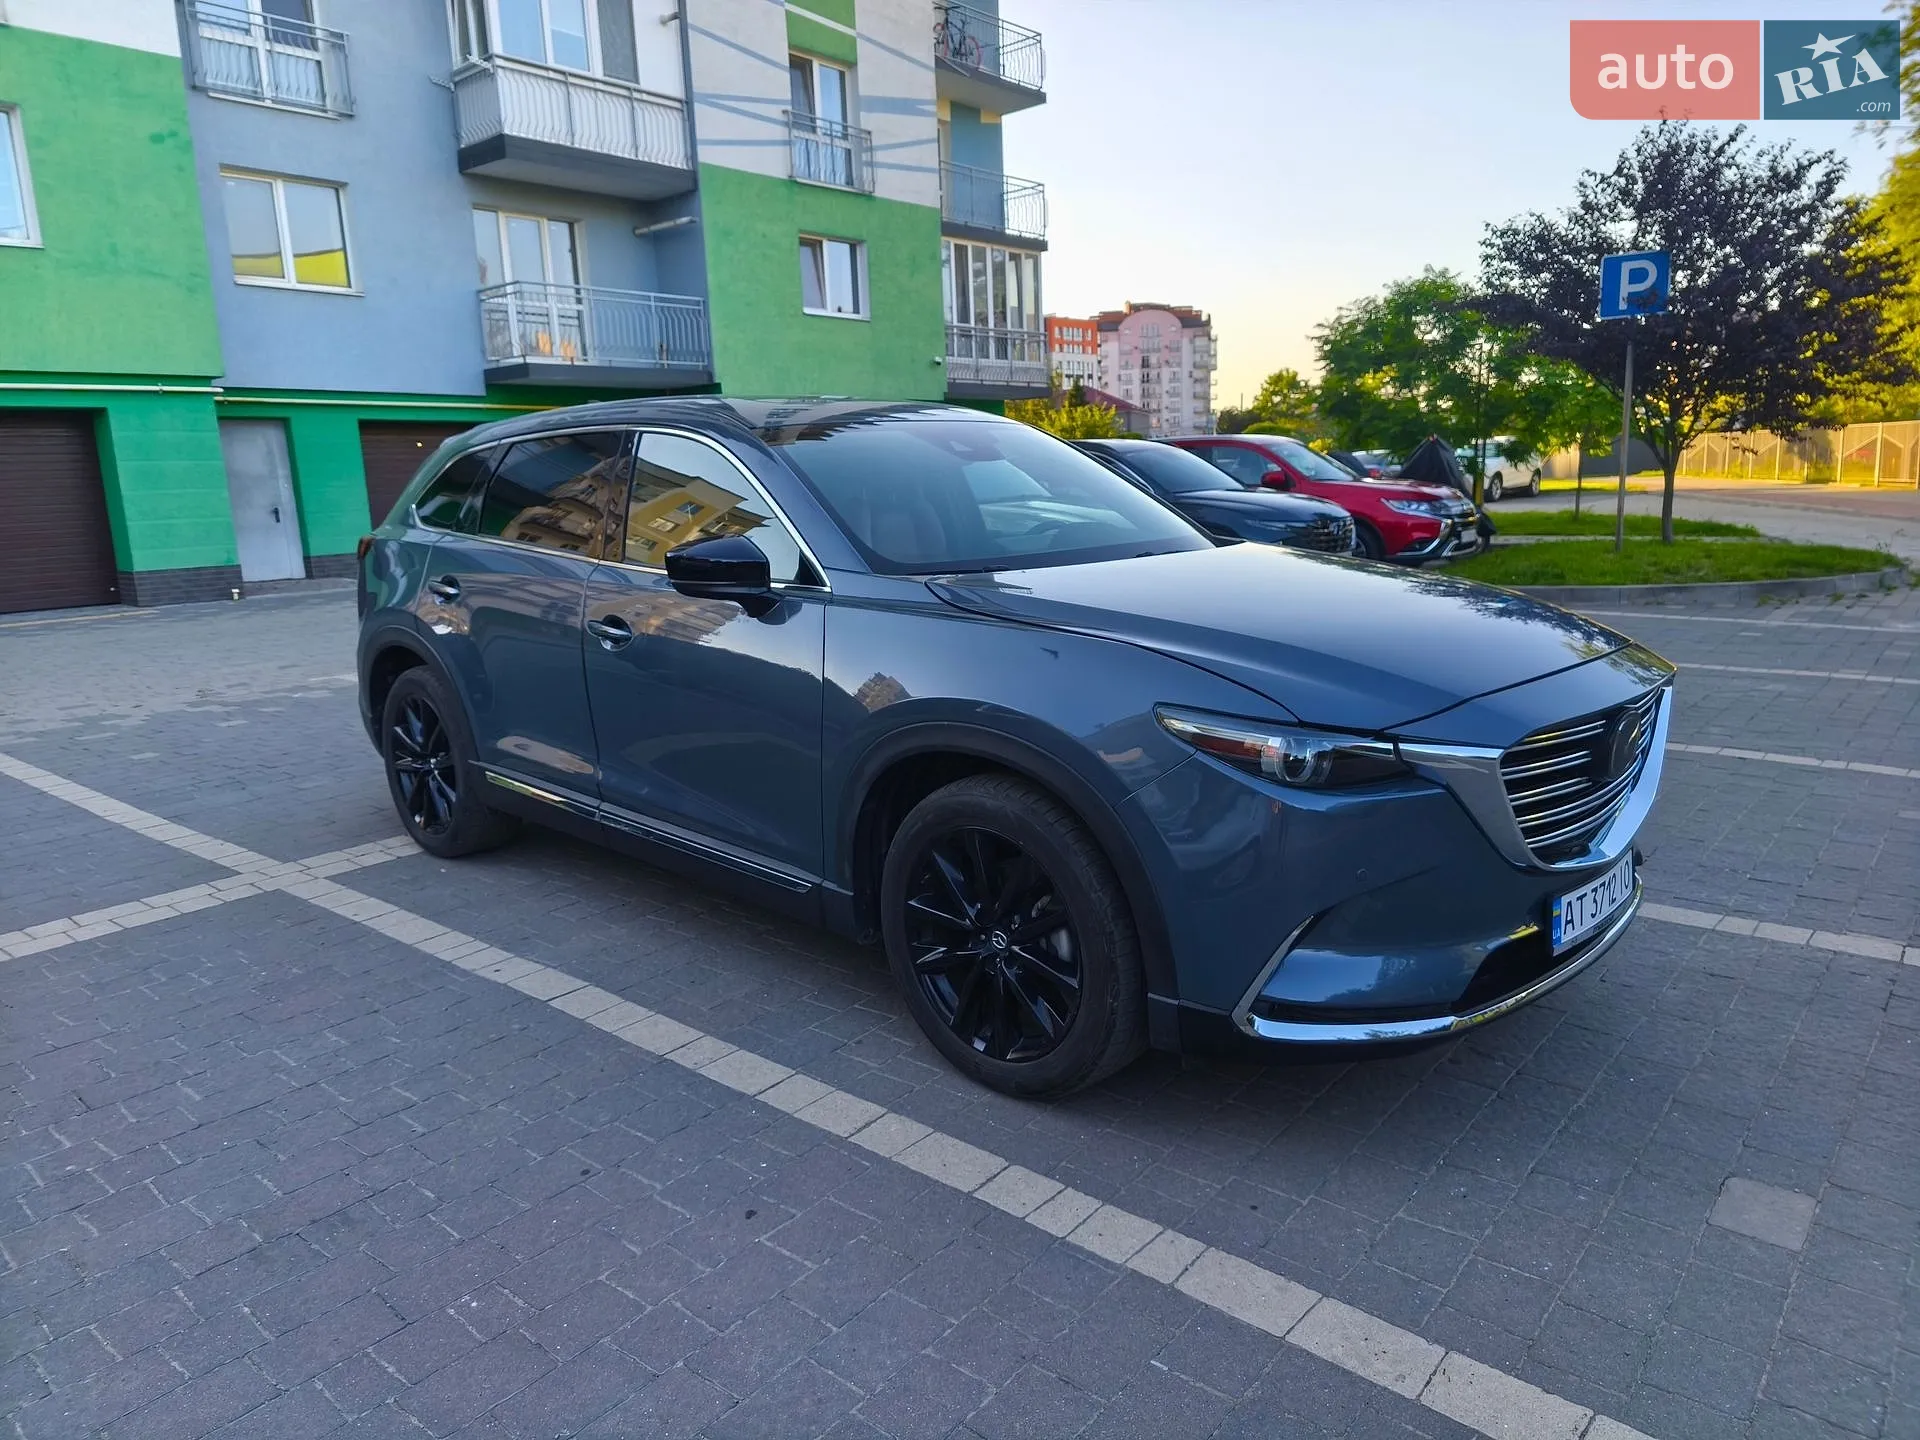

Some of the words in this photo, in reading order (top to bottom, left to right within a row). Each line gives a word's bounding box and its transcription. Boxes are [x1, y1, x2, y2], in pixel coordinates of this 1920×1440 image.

[1619, 260, 1658, 310] P
[1563, 892, 1588, 936] AT
[1590, 873, 1617, 919] 3712
[1552, 928, 1561, 940] UA
